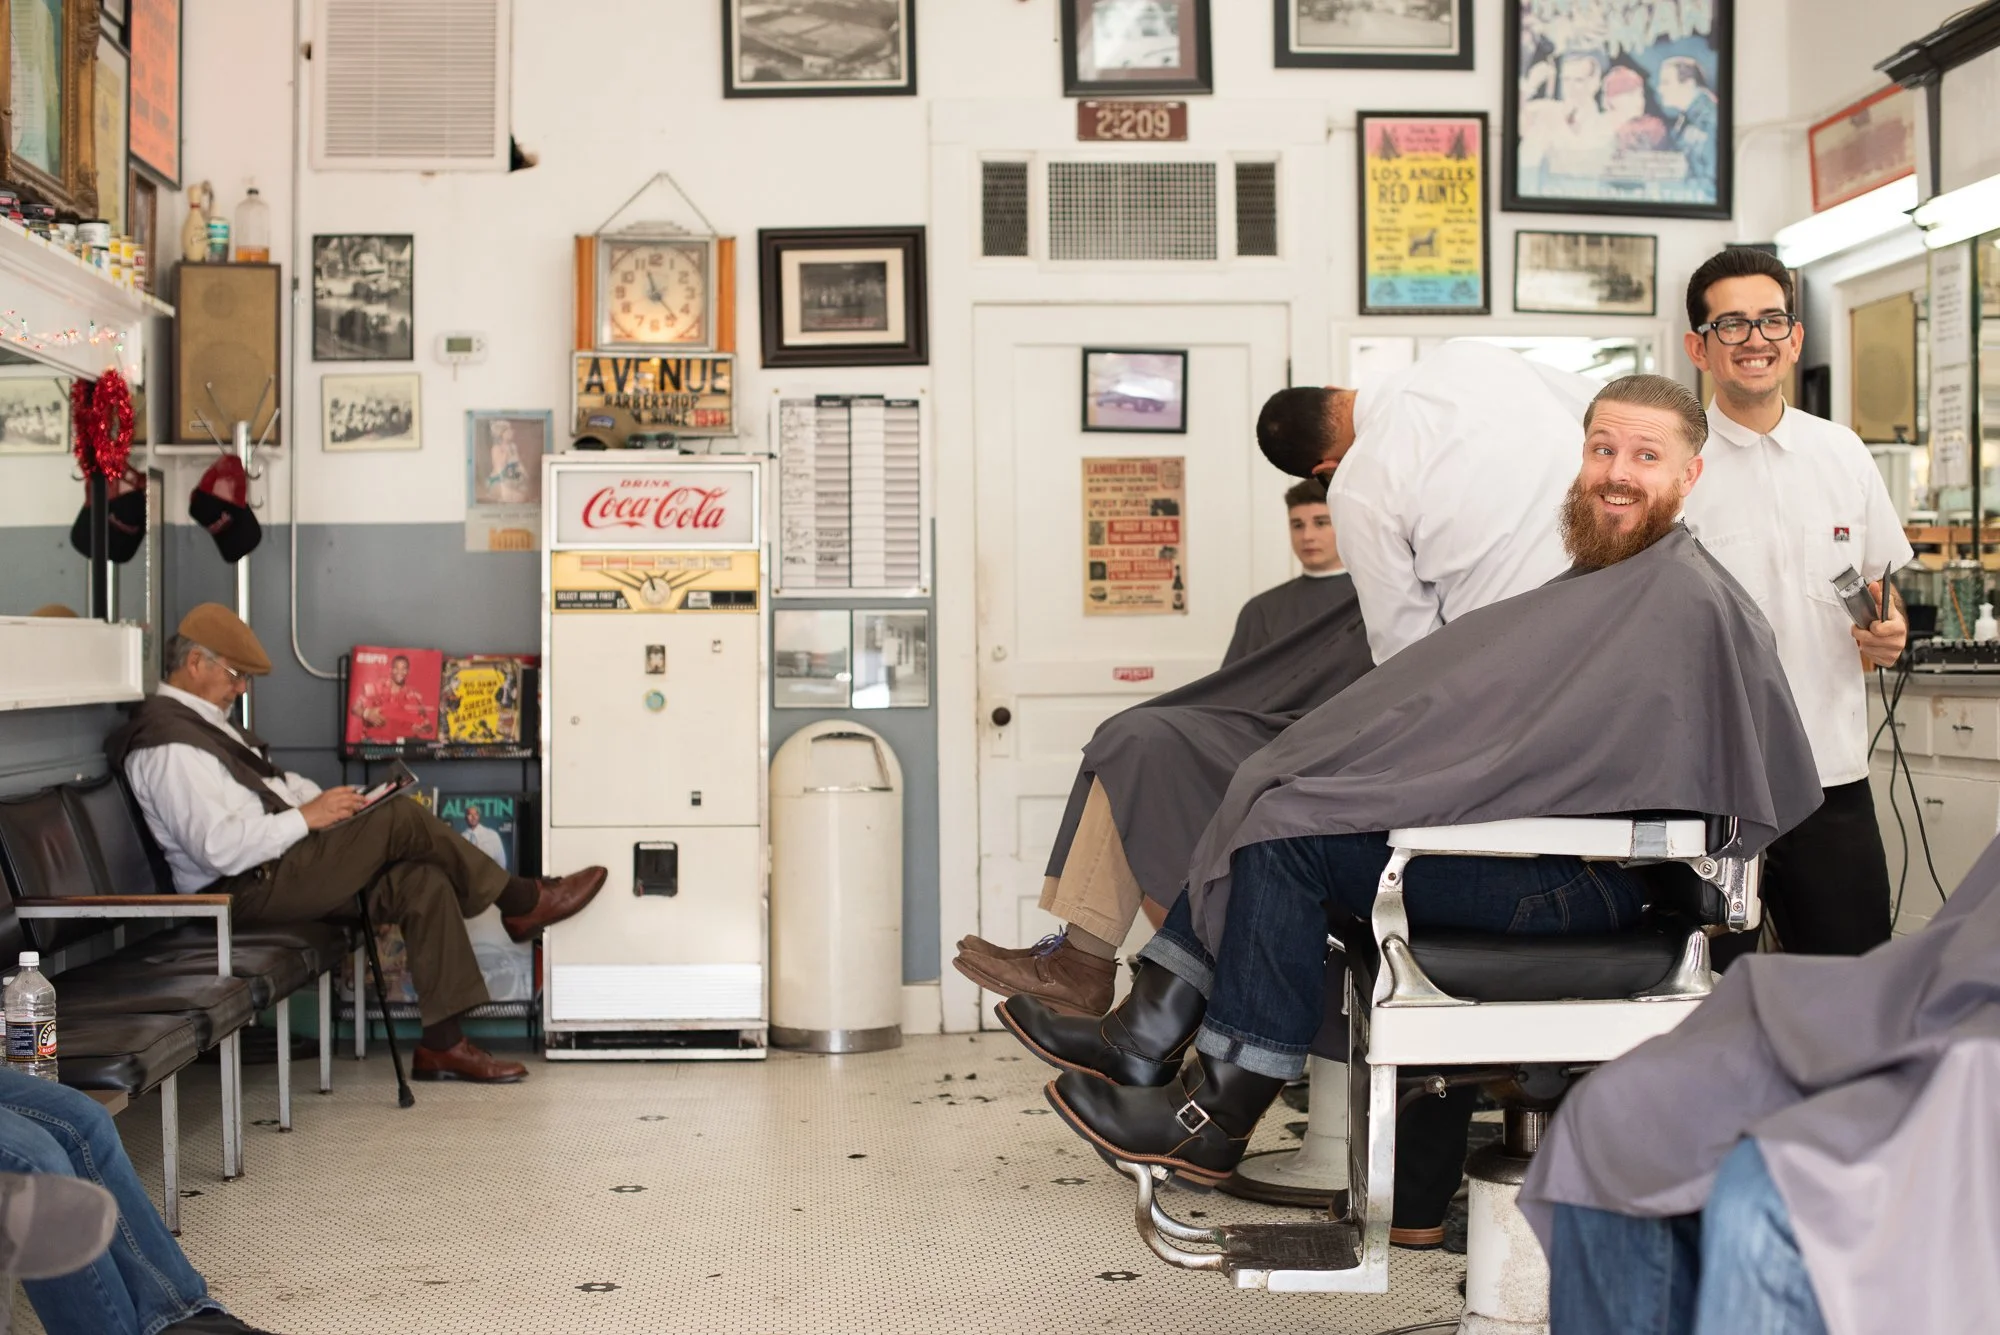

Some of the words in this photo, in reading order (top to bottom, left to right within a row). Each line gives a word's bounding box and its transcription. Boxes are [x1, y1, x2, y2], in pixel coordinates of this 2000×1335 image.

[1371, 166, 1402, 182] LOS
[1409, 165, 1476, 181] ANGELES
[1378, 183, 1410, 204] RED
[1416, 182, 1470, 205] AUNTS
[584, 357, 730, 394] AVENUE
[620, 479, 673, 488] DRINK
[557, 591, 578, 601] SELECT
[579, 591, 598, 601] DRINK
[599, 591, 617, 601] FIRST
[356, 652, 388, 665] ESPN
